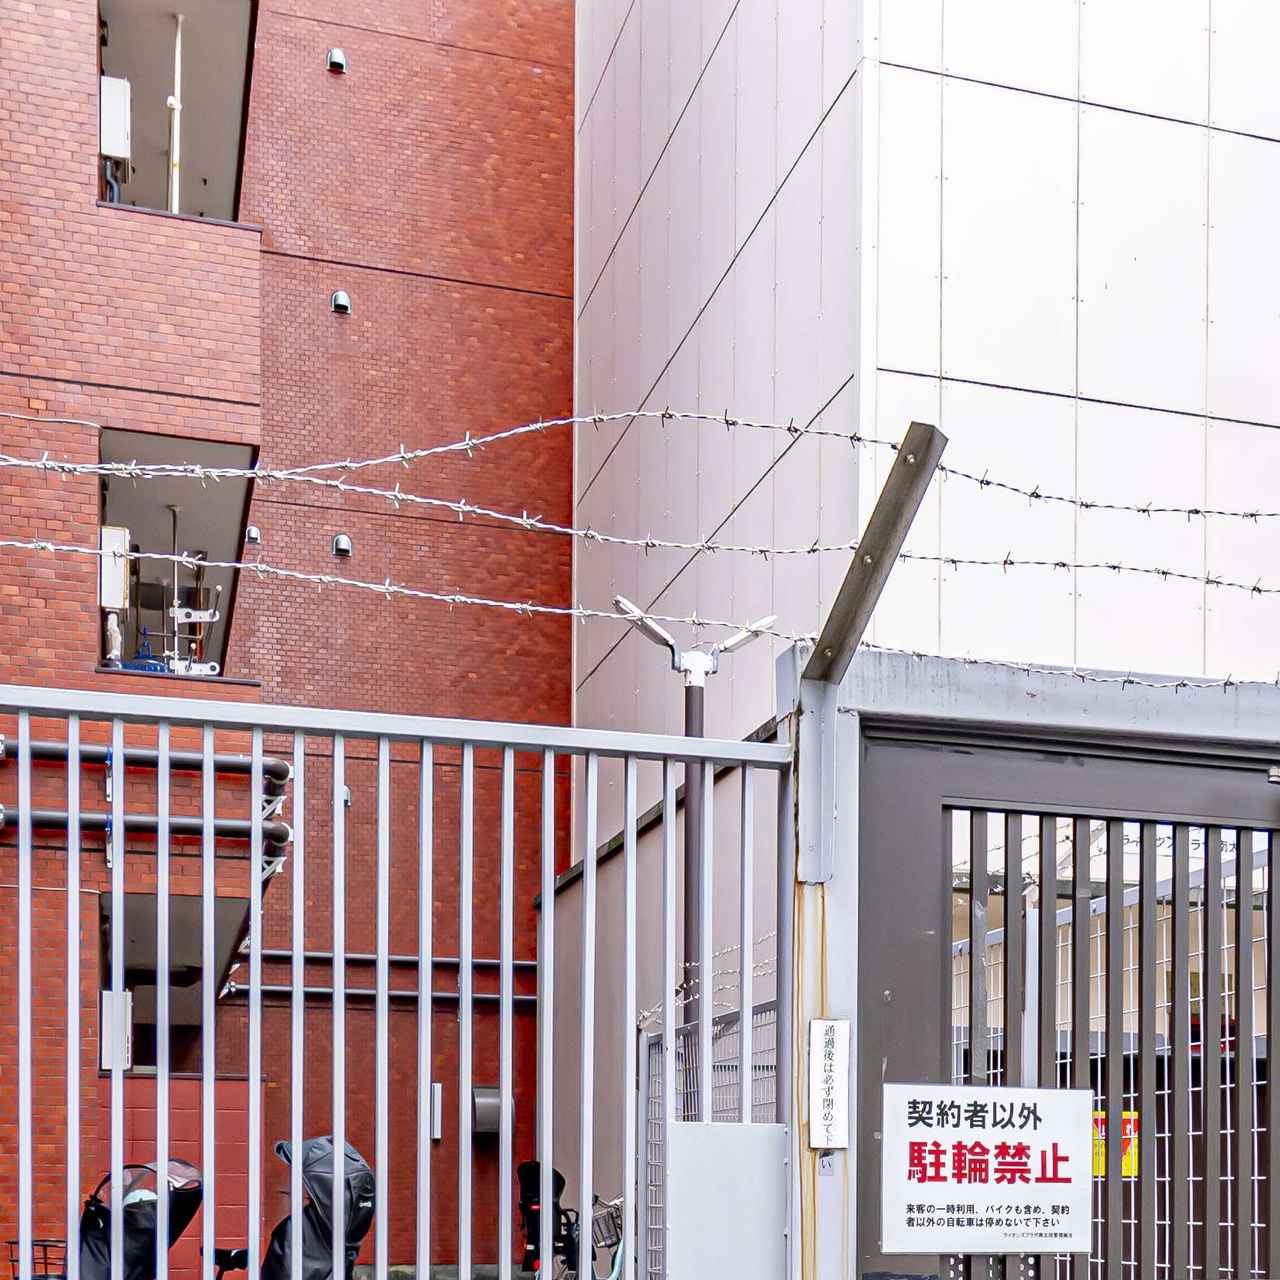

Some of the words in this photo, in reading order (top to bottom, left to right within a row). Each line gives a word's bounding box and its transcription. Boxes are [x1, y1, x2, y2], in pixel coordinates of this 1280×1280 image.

[907, 1099, 1043, 1130] 契約者以外
[907, 1140, 1072, 1184] 駐輪禁止
[905, 1217, 1060, 1228] 者以外の自転車は停めないで下さい
